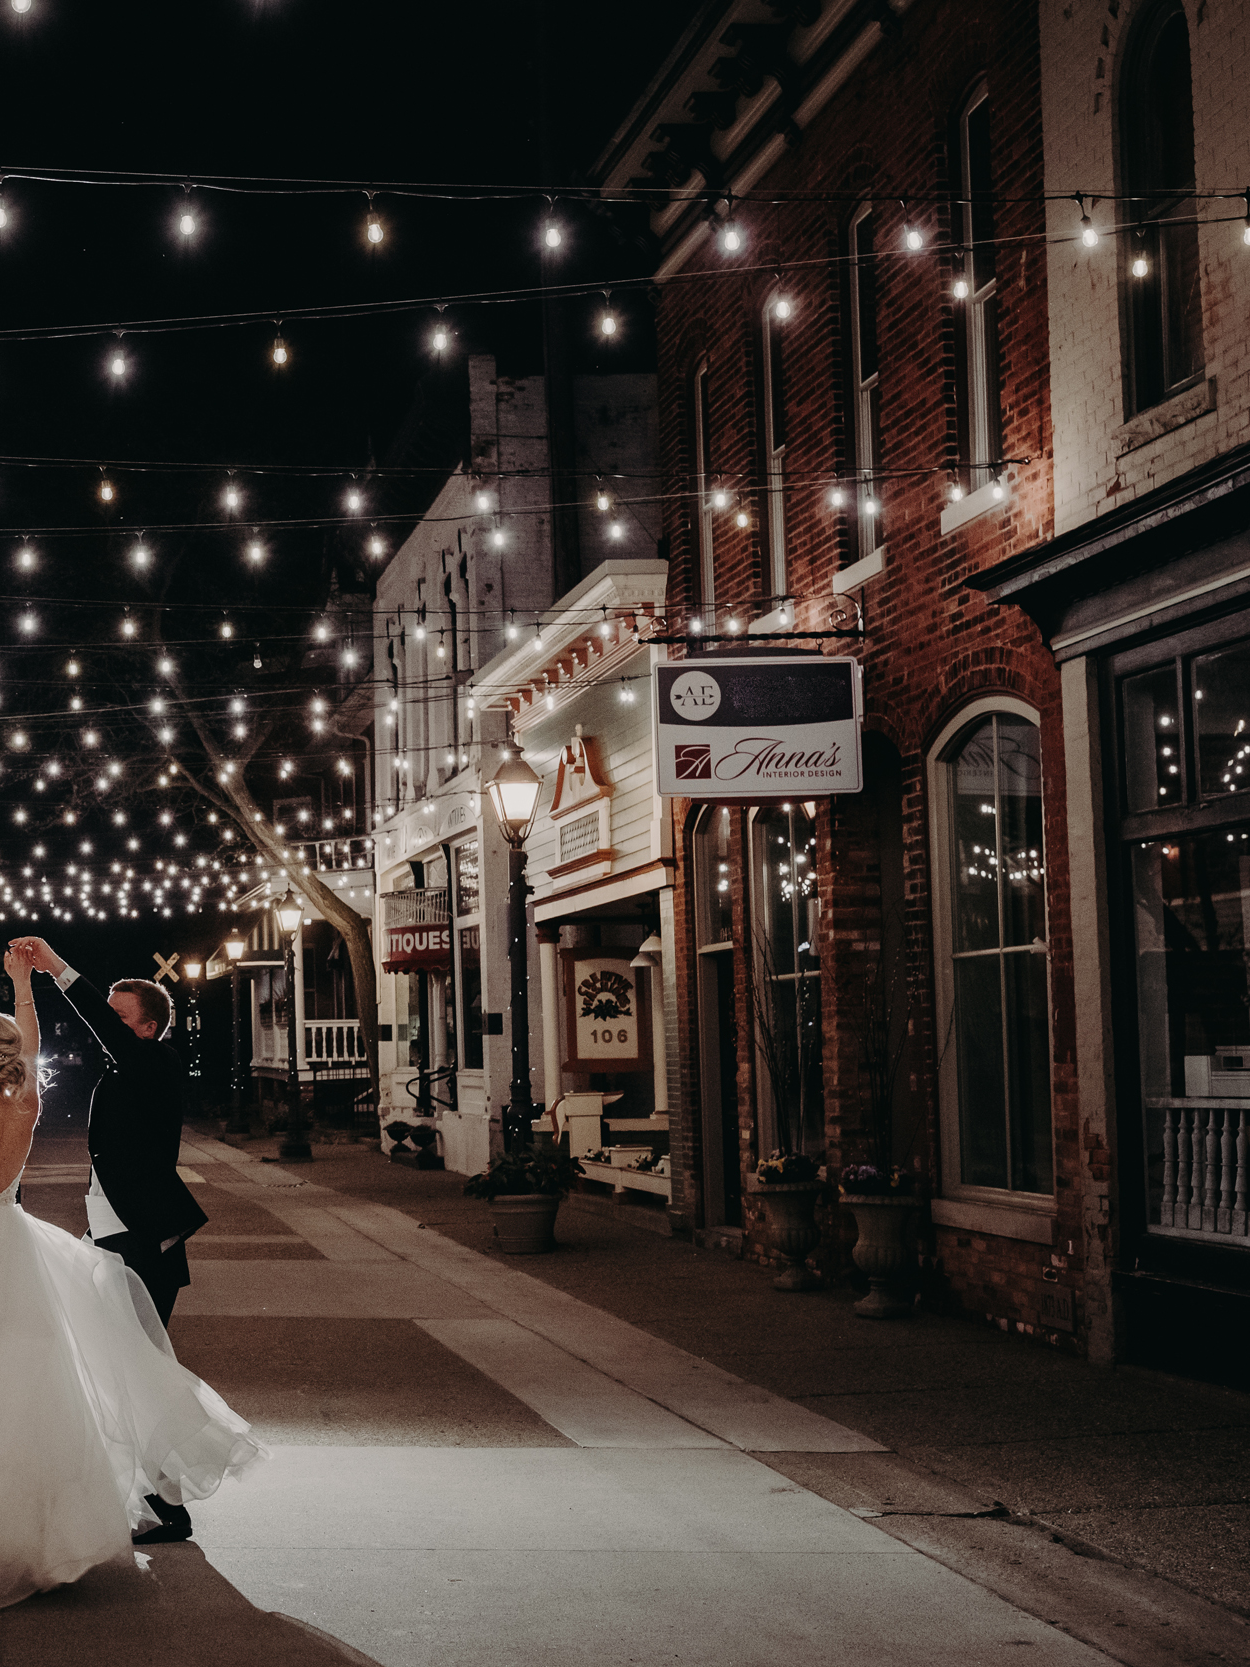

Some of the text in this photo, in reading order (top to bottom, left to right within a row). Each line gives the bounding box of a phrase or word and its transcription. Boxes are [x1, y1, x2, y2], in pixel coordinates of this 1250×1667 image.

[714, 737, 842, 781] Anna's
[762, 769, 843, 779] INTERIOR DESIGN
[388, 929, 450, 954] TIQUES
[590, 1029, 628, 1044] 106
